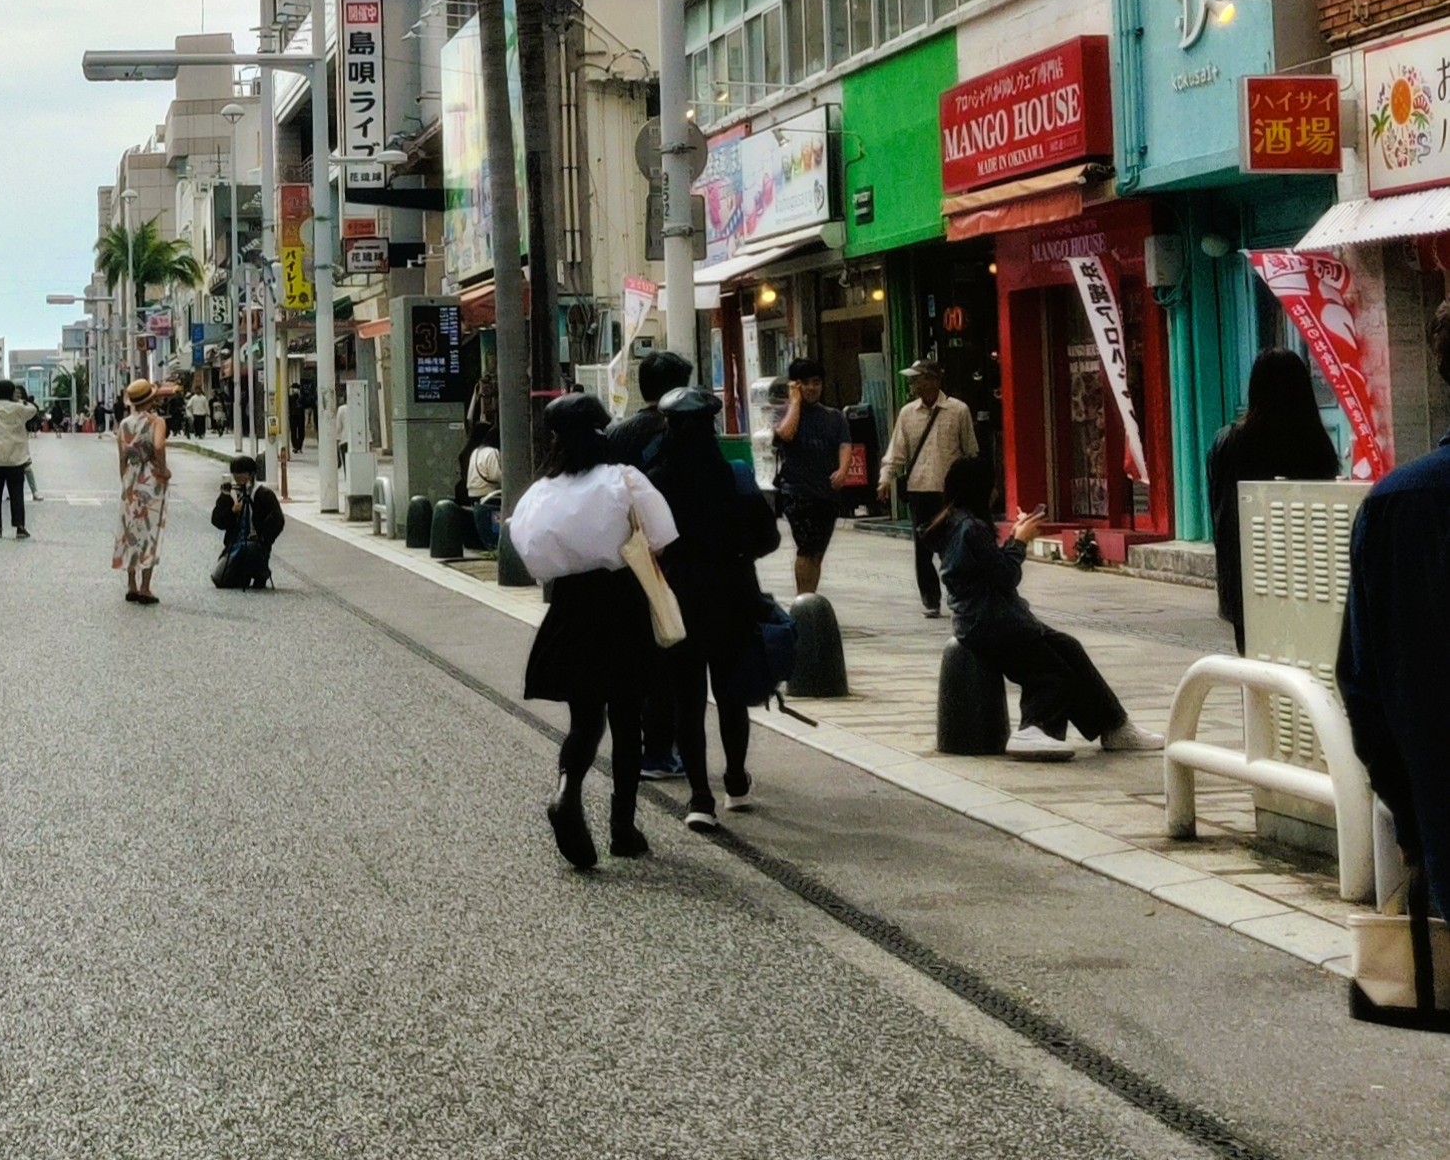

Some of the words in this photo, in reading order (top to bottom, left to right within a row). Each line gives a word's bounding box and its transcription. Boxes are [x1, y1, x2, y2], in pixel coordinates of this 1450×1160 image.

[1251, 92, 1335, 112] ハイサイ
[943, 109, 1009, 163] MANGO
[1012, 83, 1081, 142] HOUSE
[1253, 116, 1336, 156] 酒場
[977, 156, 998, 176] MADE
[998, 152, 1007, 168] IN
[1008, 143, 1044, 167] OKINAWA
